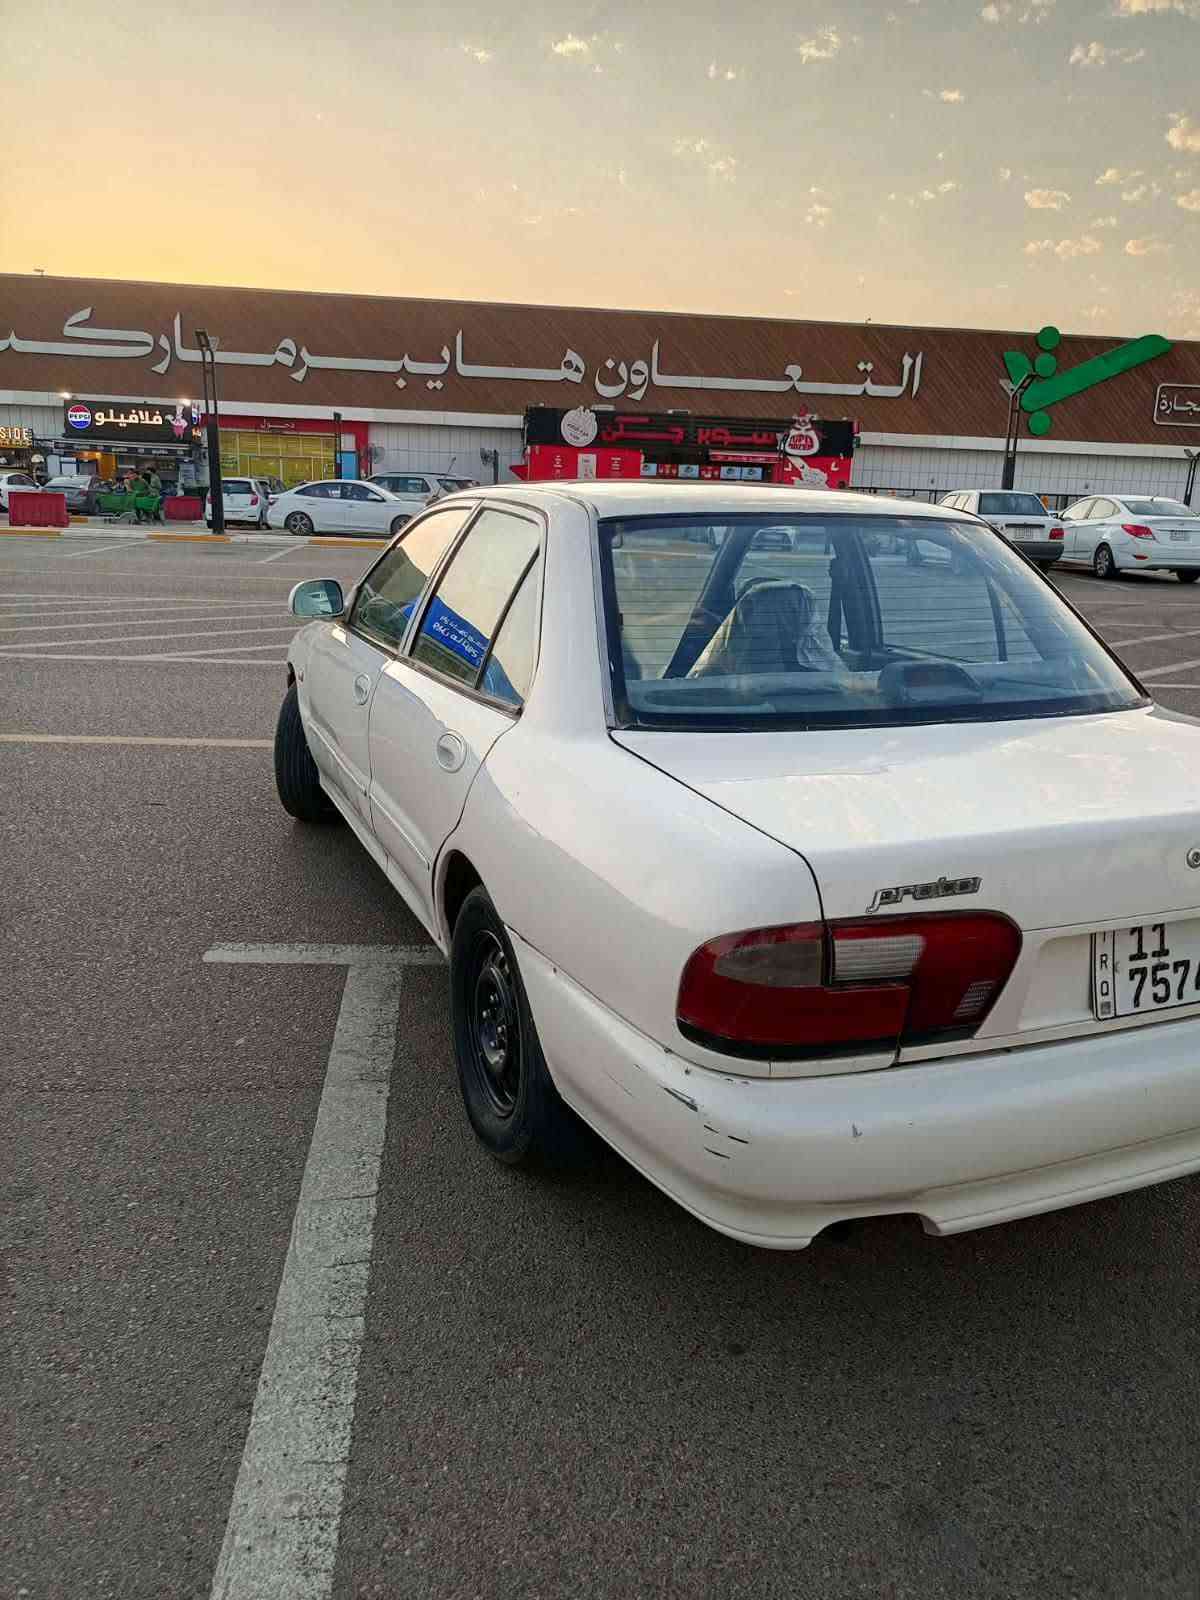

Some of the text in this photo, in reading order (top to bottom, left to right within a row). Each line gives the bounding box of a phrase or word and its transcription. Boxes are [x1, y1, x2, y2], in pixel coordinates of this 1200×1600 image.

[595, 336, 923, 401] التعاون
[94, 409, 163, 427] فلافيلو
[1128, 923, 1170, 962] 11
